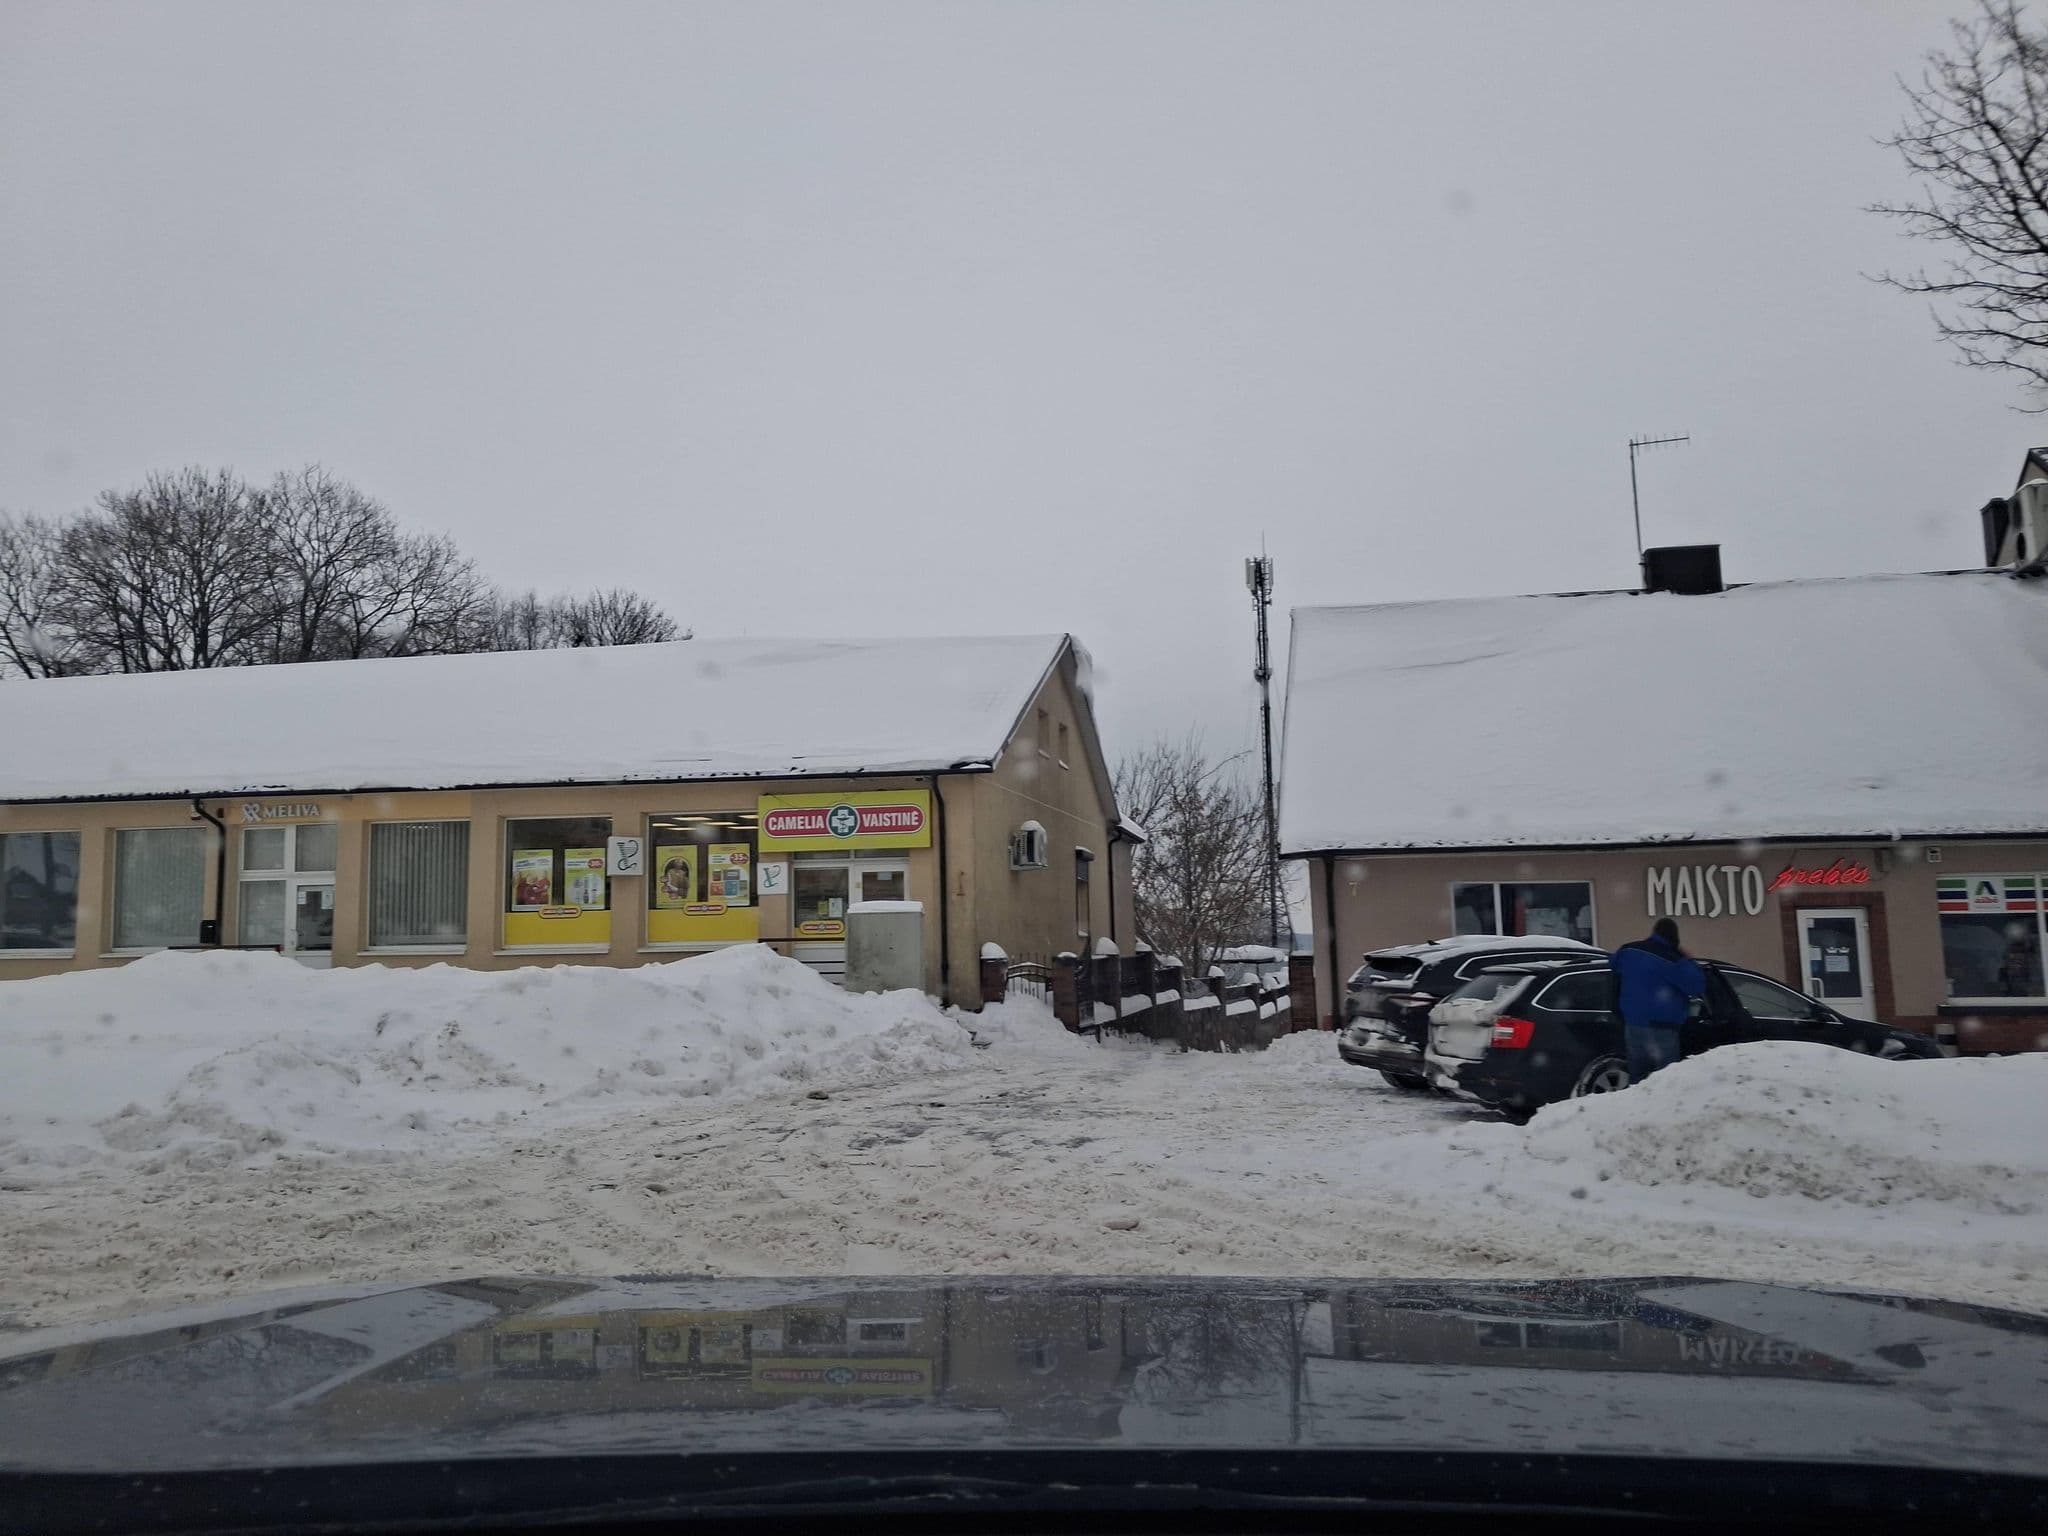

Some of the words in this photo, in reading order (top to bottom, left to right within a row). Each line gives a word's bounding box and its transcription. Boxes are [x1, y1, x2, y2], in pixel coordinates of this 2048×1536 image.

[263, 804, 320, 818] MELIVA
[768, 815, 825, 830] CAMELIA
[862, 811, 919, 827] VAISTINĖ
[1648, 864, 1764, 918] MAISTO
